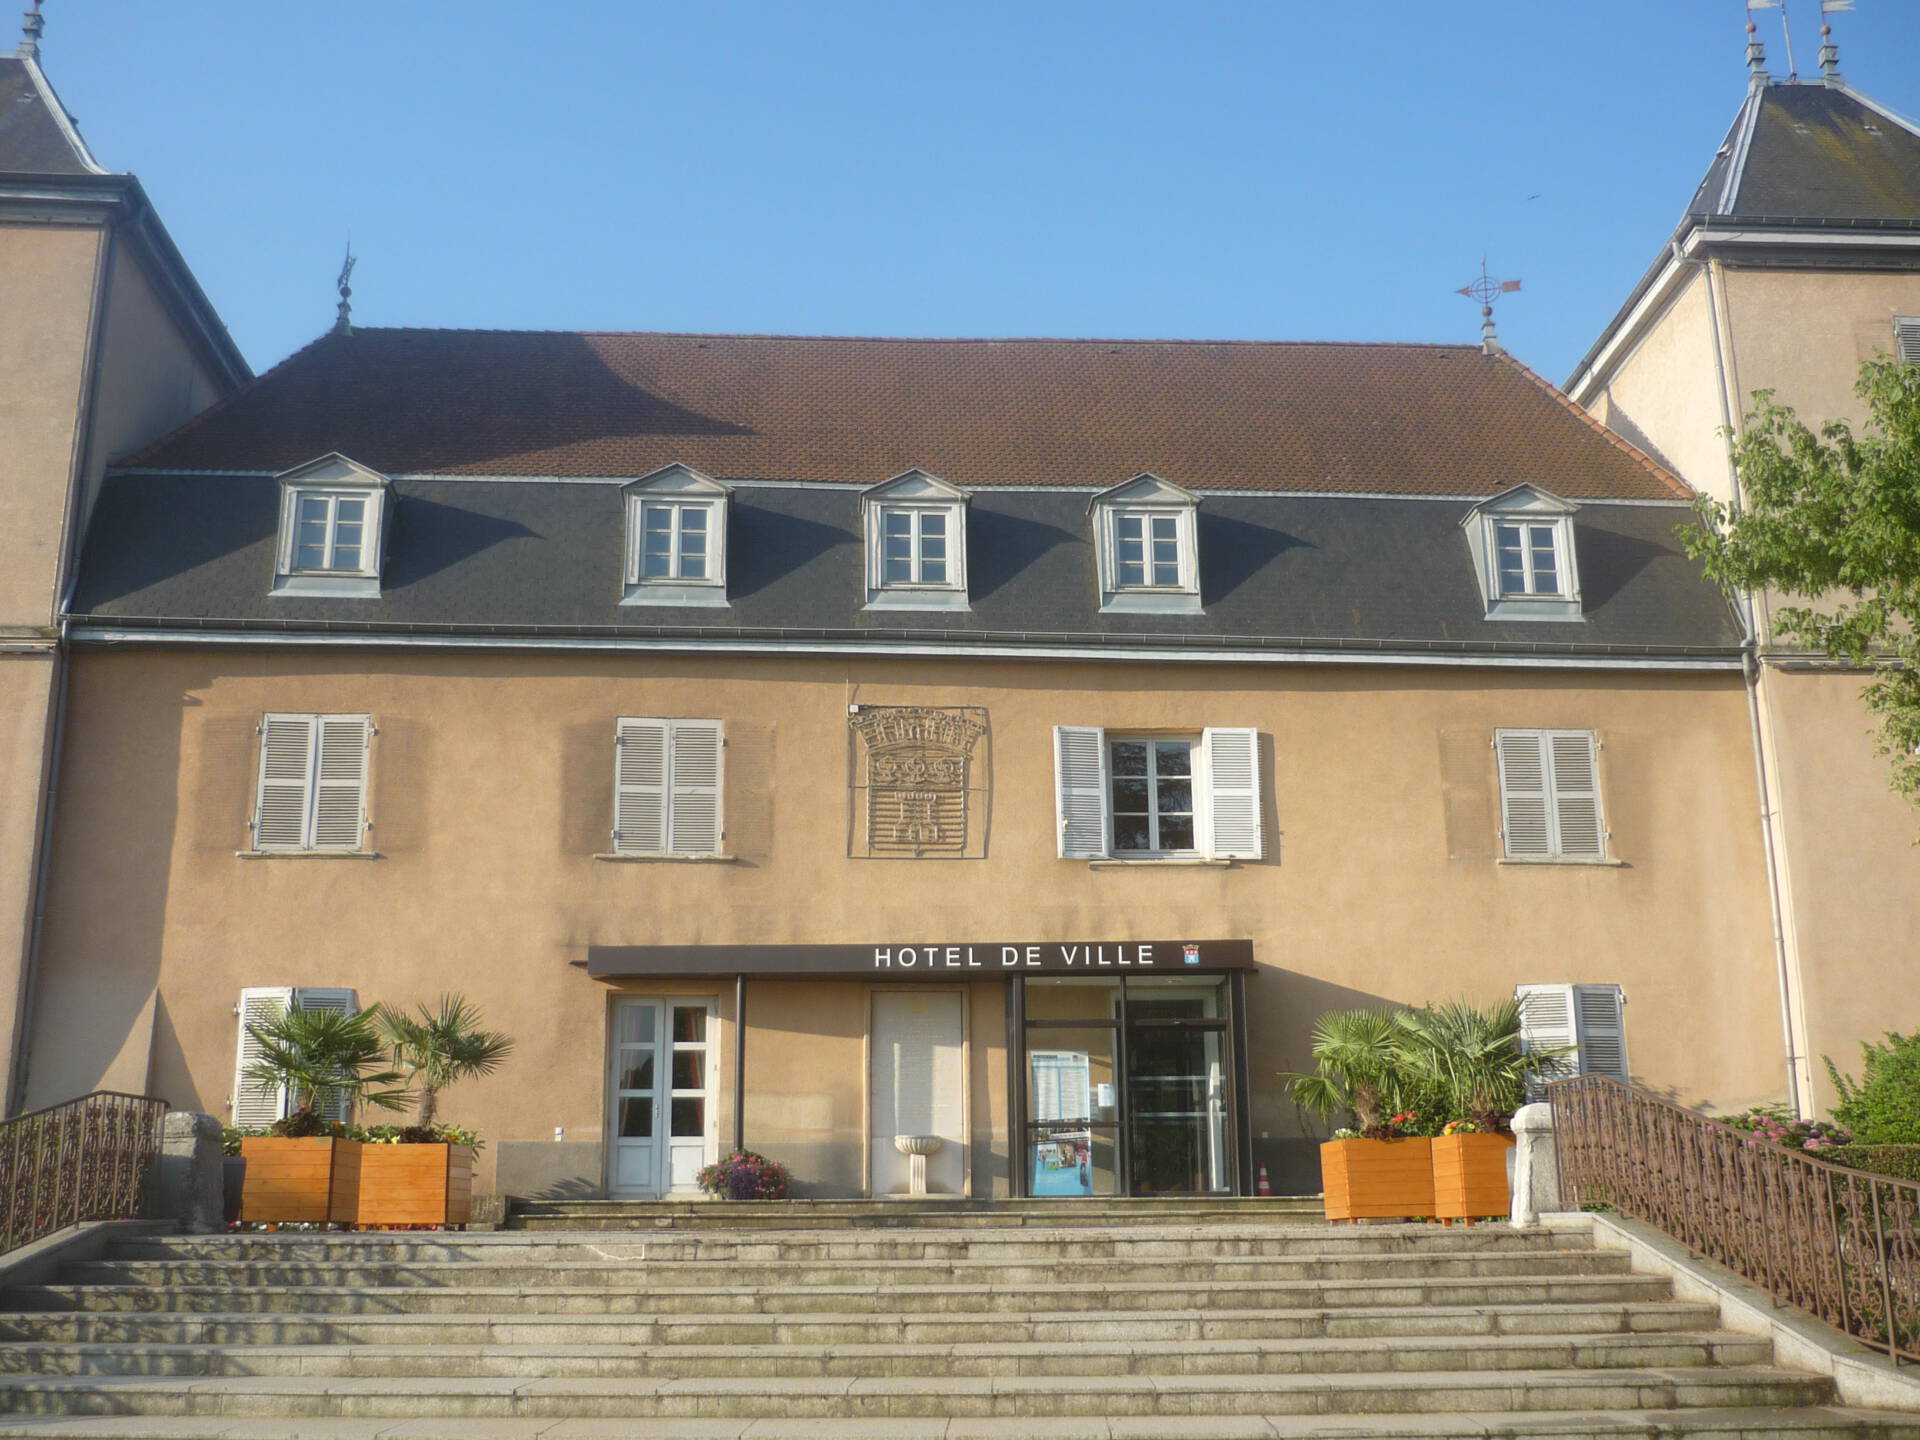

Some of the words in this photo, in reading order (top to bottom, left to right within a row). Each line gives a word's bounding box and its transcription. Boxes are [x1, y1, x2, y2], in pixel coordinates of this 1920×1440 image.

[874, 947, 982, 968] HOTEL
[1001, 946, 1042, 967] DE
[1060, 945, 1154, 966] VILLE
